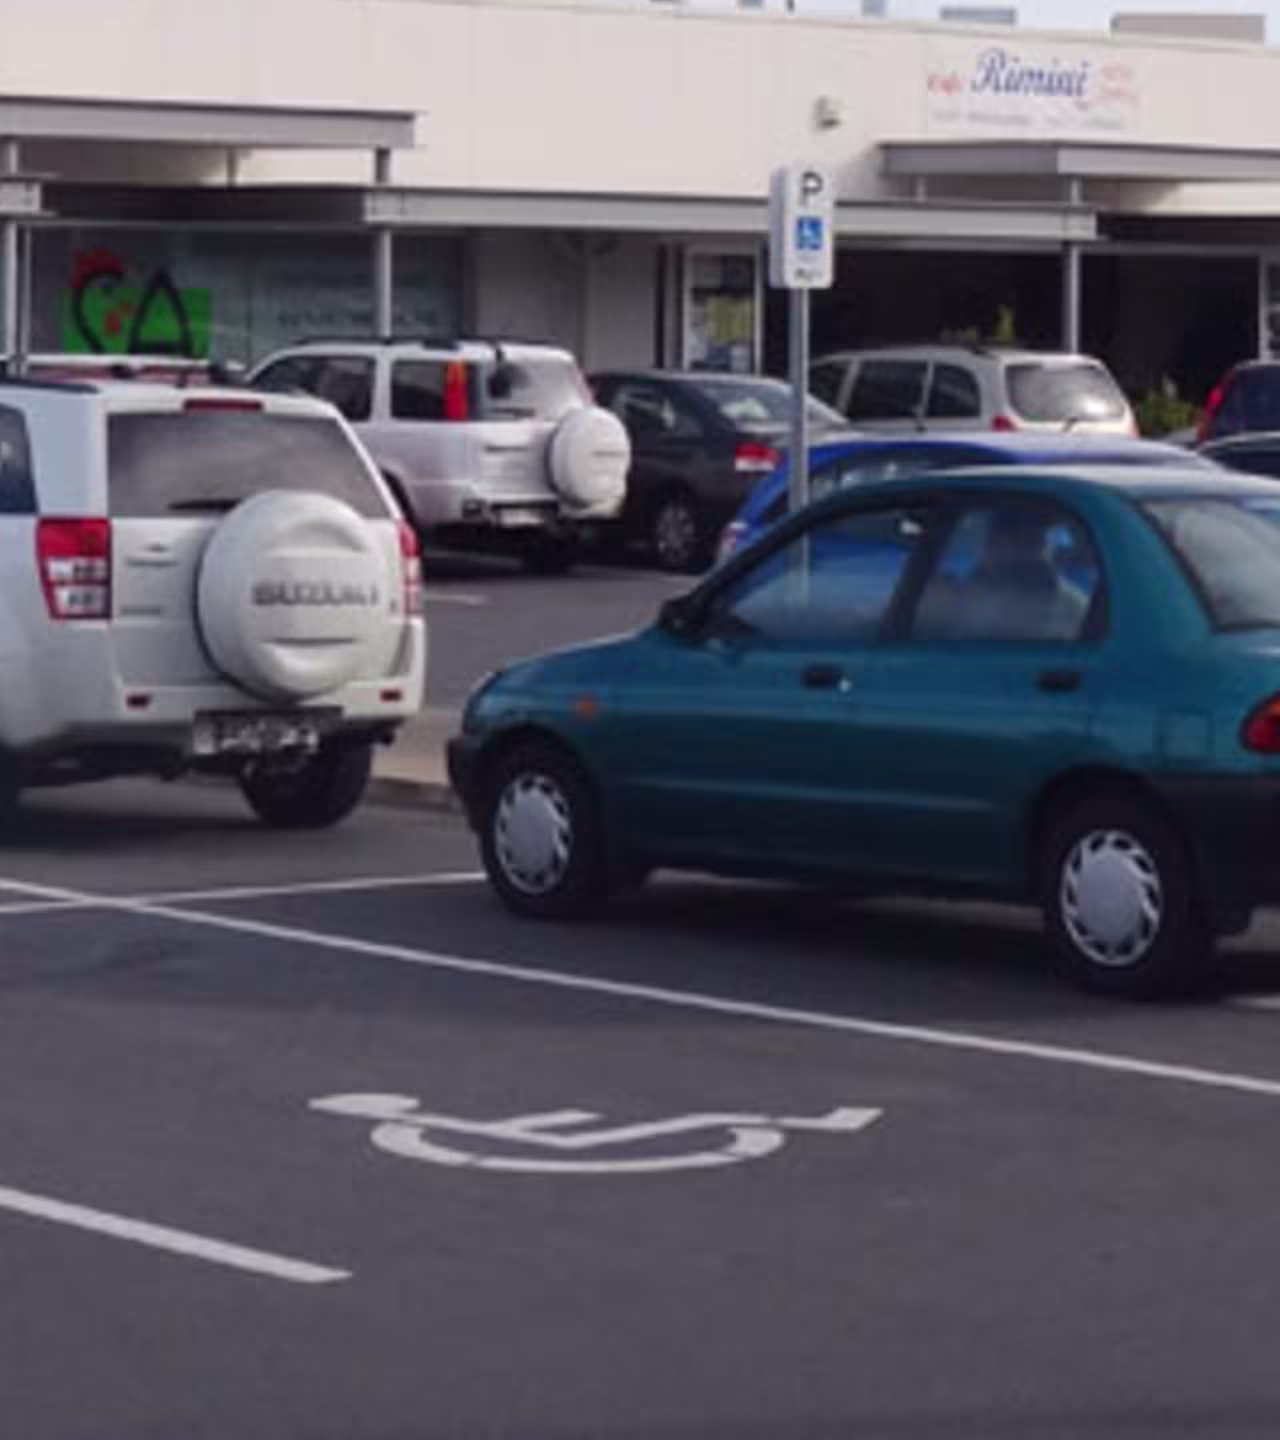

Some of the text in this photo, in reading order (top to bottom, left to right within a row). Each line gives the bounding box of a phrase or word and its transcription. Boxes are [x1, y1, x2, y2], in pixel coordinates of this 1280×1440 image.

[971, 46, 1093, 98] Rimini
[801, 170, 825, 208] P
[252, 580, 378, 607] SUZUKI
